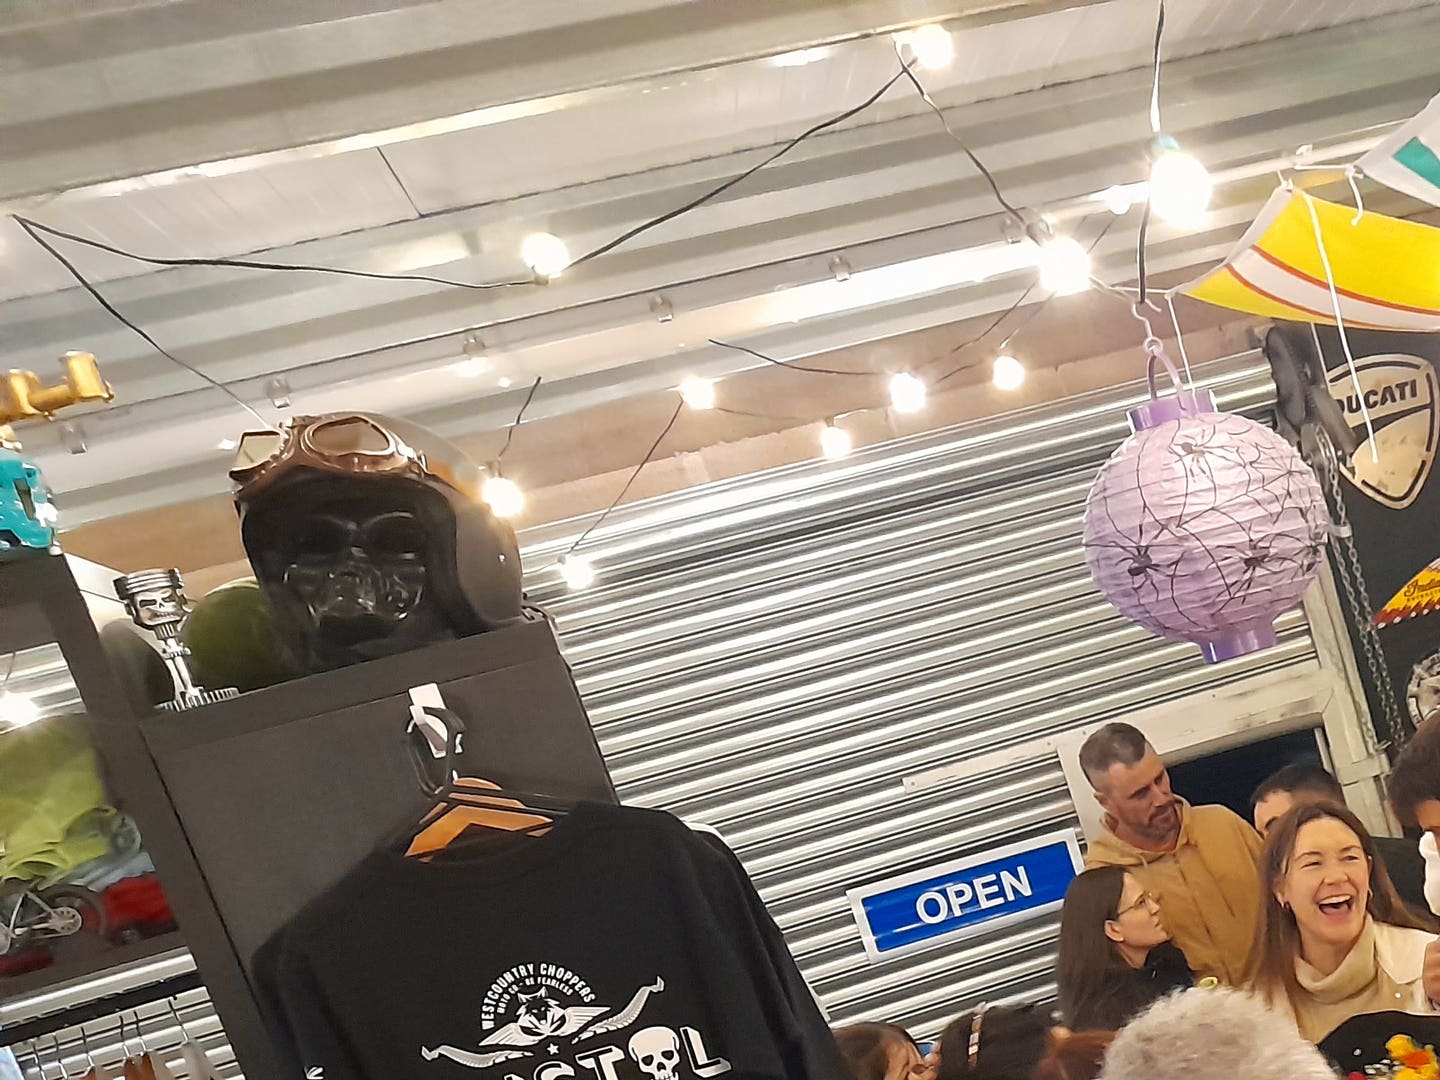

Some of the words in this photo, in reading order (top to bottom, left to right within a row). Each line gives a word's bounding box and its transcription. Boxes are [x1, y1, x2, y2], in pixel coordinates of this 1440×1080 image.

[915, 865, 1033, 925] OPEN
[481, 963, 534, 1030] WESTCOUNTRY
[540, 963, 596, 1003] CHOPPERS
[538, 977, 574, 996] FEARLESS
